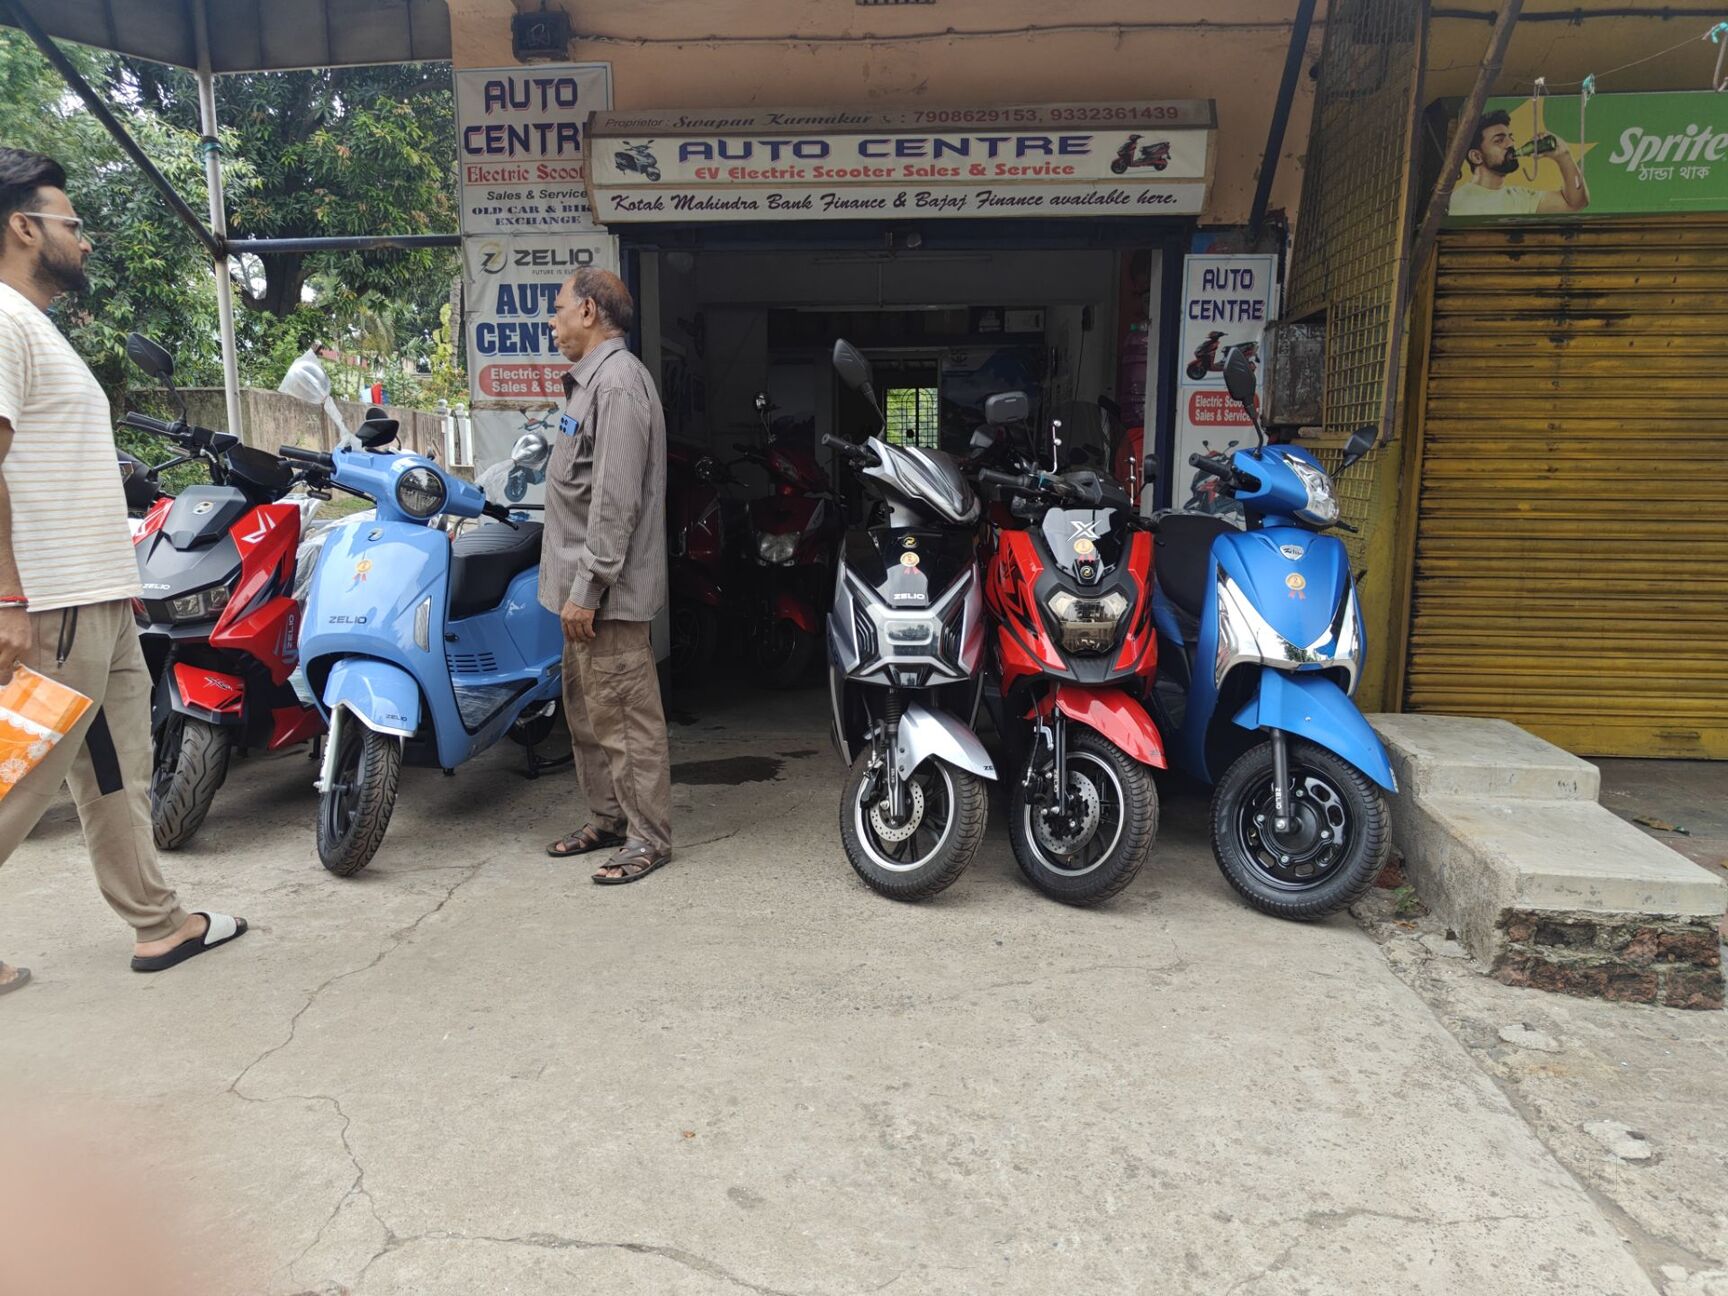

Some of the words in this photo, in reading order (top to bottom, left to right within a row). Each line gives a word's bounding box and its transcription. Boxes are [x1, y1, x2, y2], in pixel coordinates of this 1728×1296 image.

[484, 76, 578, 115] AUTO
[914, 109, 1043, 124] 7908629153,
[1051, 106, 1178, 121] 9332361439
[678, 138, 831, 164] AUTO
[858, 135, 1095, 161] CENTRE
[1608, 123, 1728, 172] Sprite
[467, 165, 530, 183] Electric
[695, 168, 720, 180] EV
[728, 165, 805, 180] Electric
[812, 165, 896, 179] Scooter
[903, 163, 960, 178] Sales
[969, 163, 987, 176] &
[994, 161, 1076, 176] Service
[487, 190, 522, 201] Sales
[526, 190, 535, 200] &
[539, 188, 588, 199] Service
[611, 194, 665, 212] Kotak
[670, 193, 759, 210] Mahindra
[767, 193, 814, 210] Bank
[820, 192, 886, 212] Finance
[893, 191, 907, 208] &
[915, 190, 968, 211] Bajaj
[975, 190, 1044, 210] Finance
[1049, 188, 1131, 206] available
[472, 206, 503, 215] OLD
[507, 205, 540, 214] CAR
[545, 205, 556, 213] &
[495, 215, 582, 225] EXCHANGE
[1203, 267, 1255, 292] AUTO
[1189, 299, 1265, 323] CENTRE
[490, 368, 540, 380] Electric
[492, 381, 527, 393] Sales
[531, 381, 541, 393] &
[1195, 395, 1223, 407] Electric
[1195, 409, 1215, 421] Sales
[328, 615, 368, 624] ZELIO
